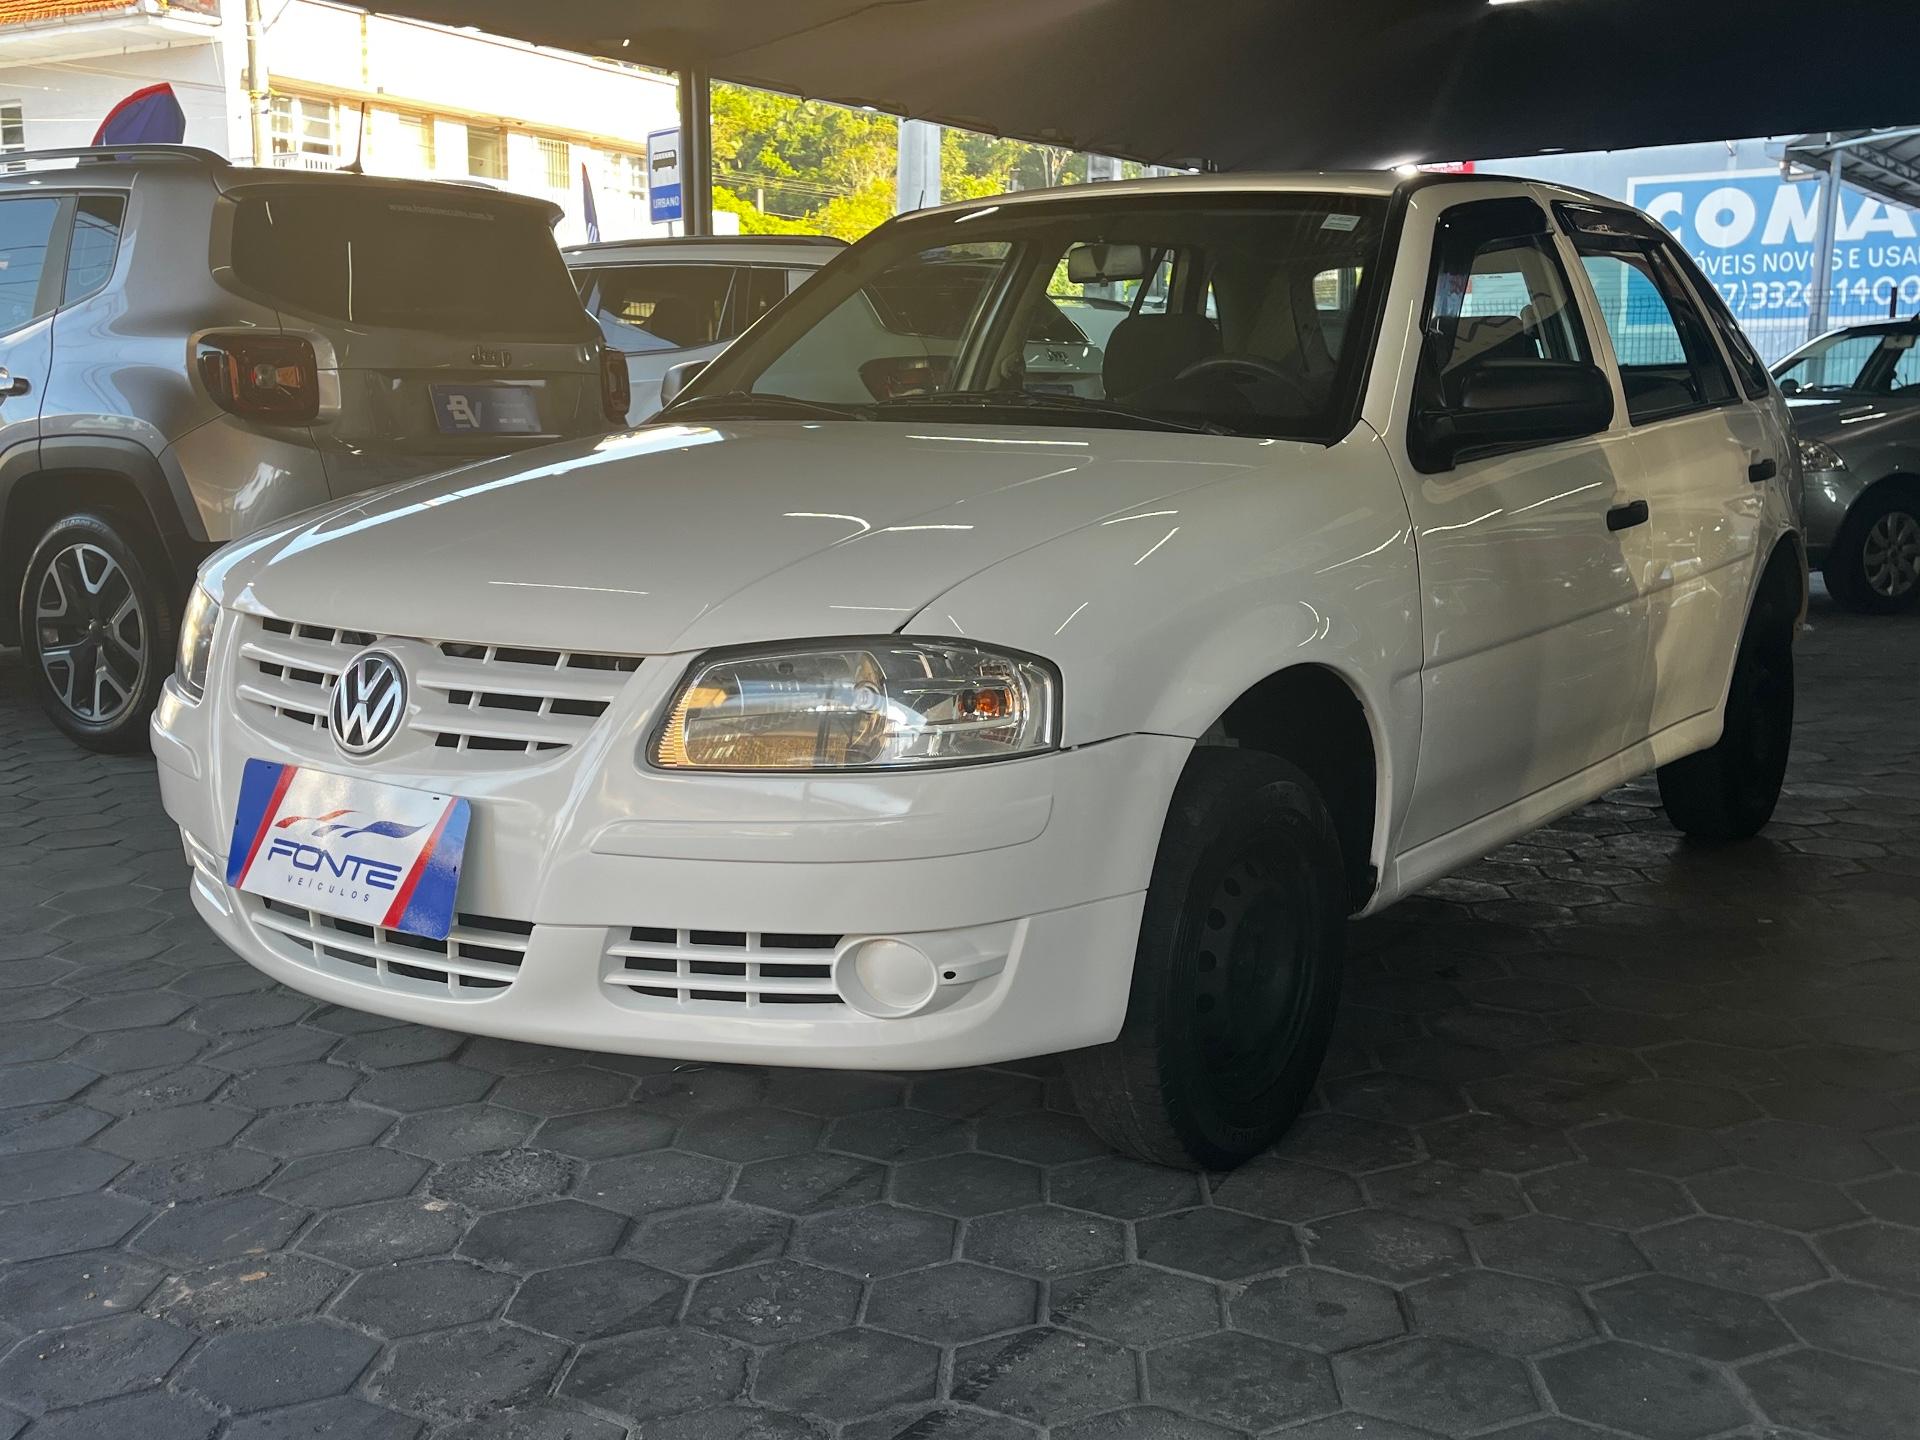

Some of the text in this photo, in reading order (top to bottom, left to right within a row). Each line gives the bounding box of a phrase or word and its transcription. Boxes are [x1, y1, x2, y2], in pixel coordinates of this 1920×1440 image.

[653, 196, 680, 209] URBANO
[1763, 247, 1843, 272] NOVS
[1849, 248, 1860, 268] E
[1868, 245, 1920, 267] USA
[267, 838, 402, 891] FONTE
